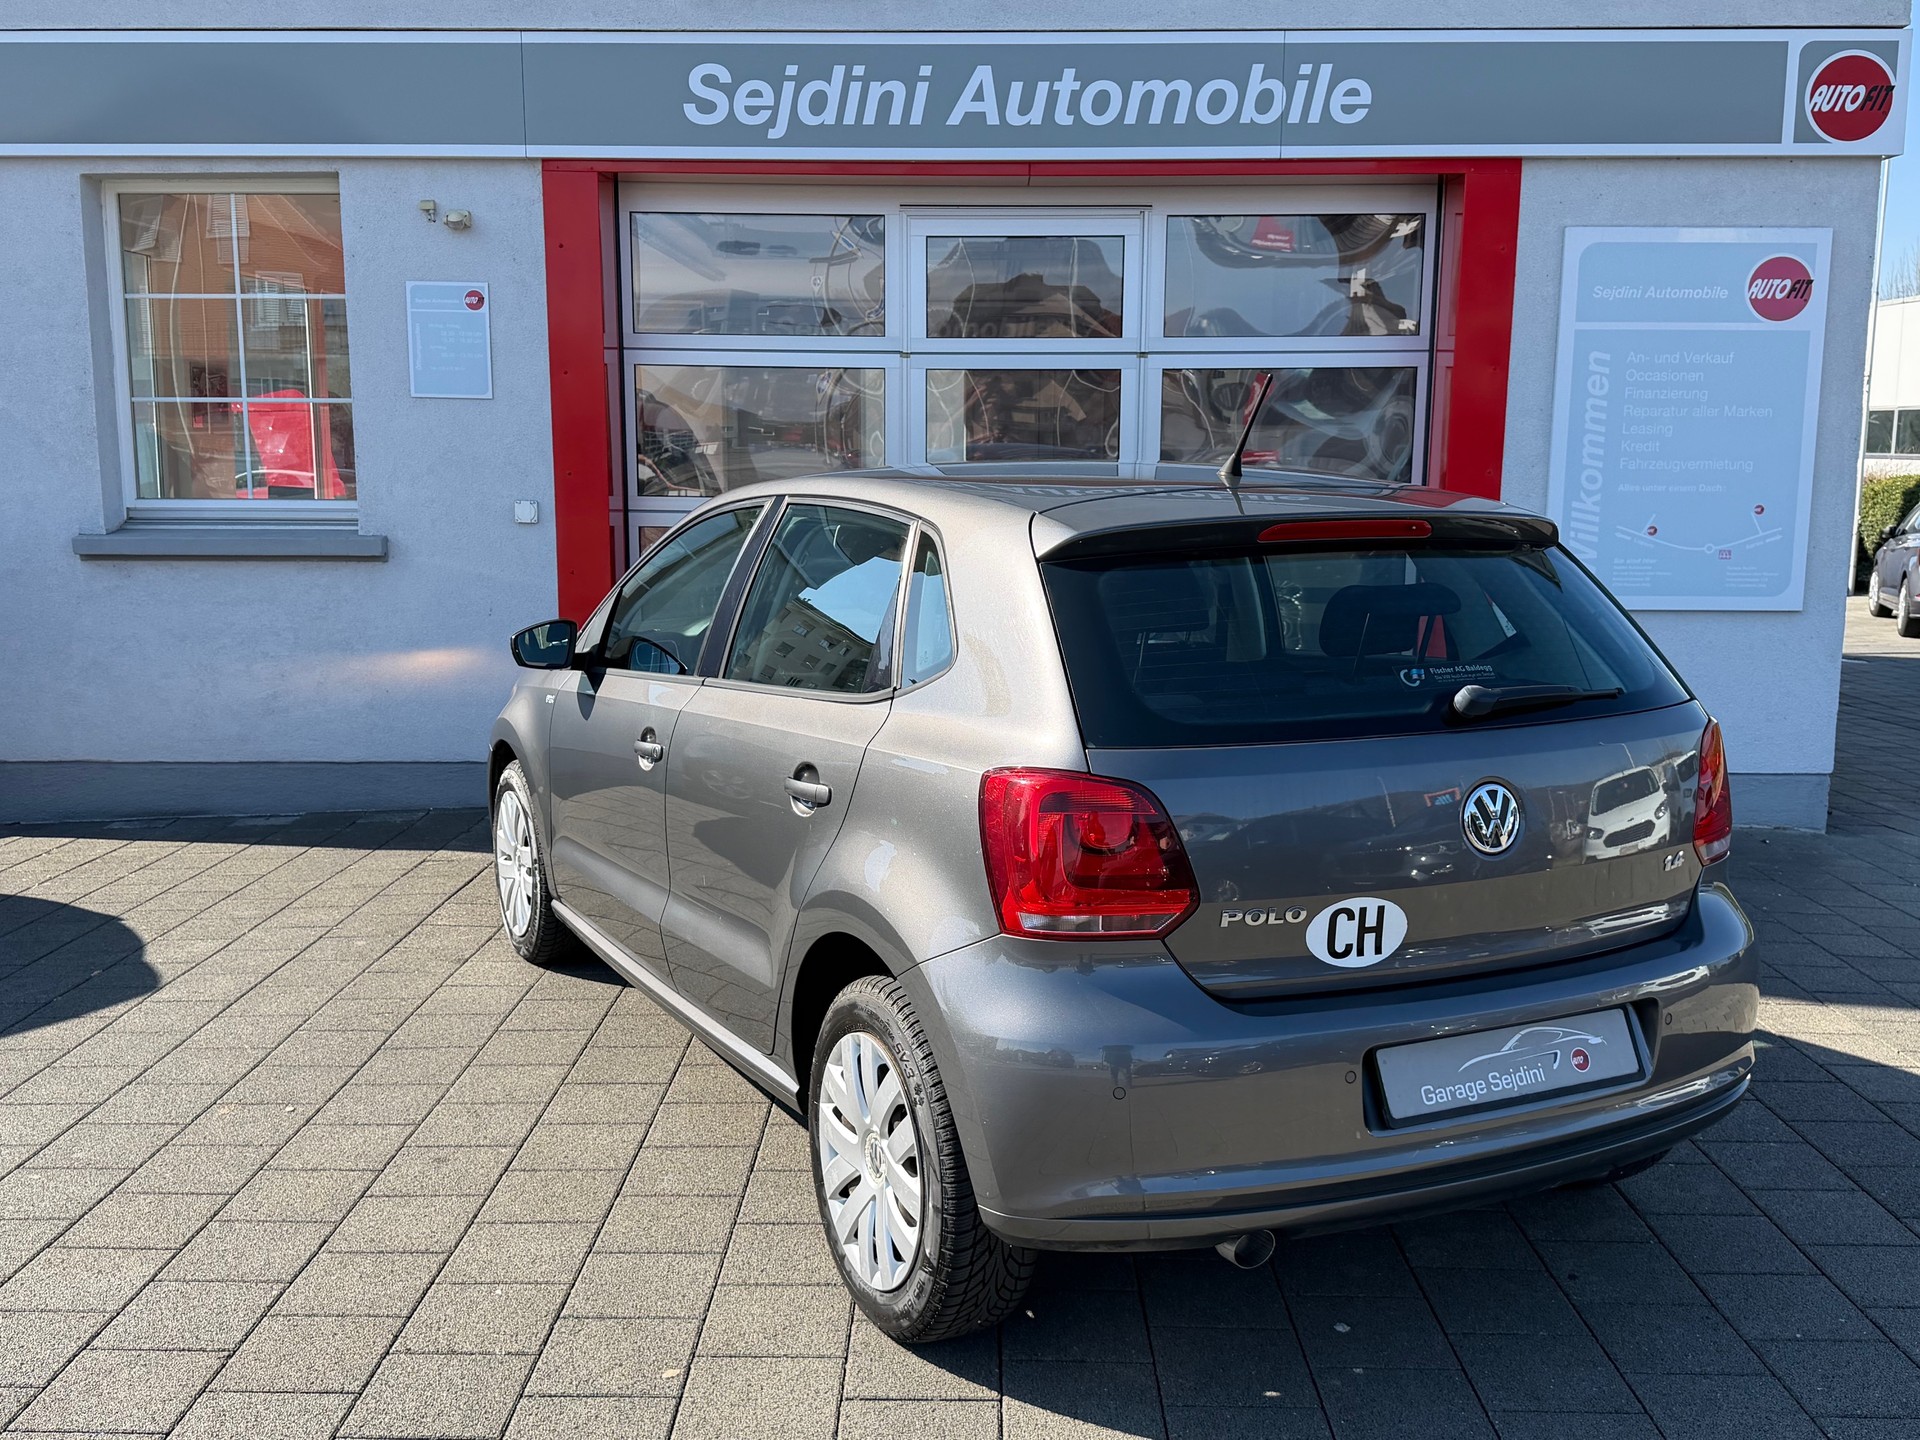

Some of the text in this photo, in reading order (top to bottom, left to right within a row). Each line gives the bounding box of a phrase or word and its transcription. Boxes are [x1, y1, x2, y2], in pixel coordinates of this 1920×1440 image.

[682, 63, 1373, 140] Sejdini Automobile
[1809, 84, 1896, 113] AUTOFIT
[1592, 285, 1729, 301] Sejdini Automobile
[1748, 278, 1814, 300] AUTOFIT
[1626, 351, 1735, 364] An- und Verkauf
[1625, 368, 1704, 382] Occasionen
[1624, 386, 1709, 402] Finanzierung
[1623, 404, 1774, 418] Reparatur aller Marken
[1622, 423, 1673, 437] Leasing
[1621, 440, 1660, 453] Kredit
[1620, 457, 1754, 472] Fahrzeugvermietung
[1219, 905, 1308, 928] POLO
[1327, 905, 1386, 960] CH
[1420, 1062, 1546, 1106] Garage Sejdini
